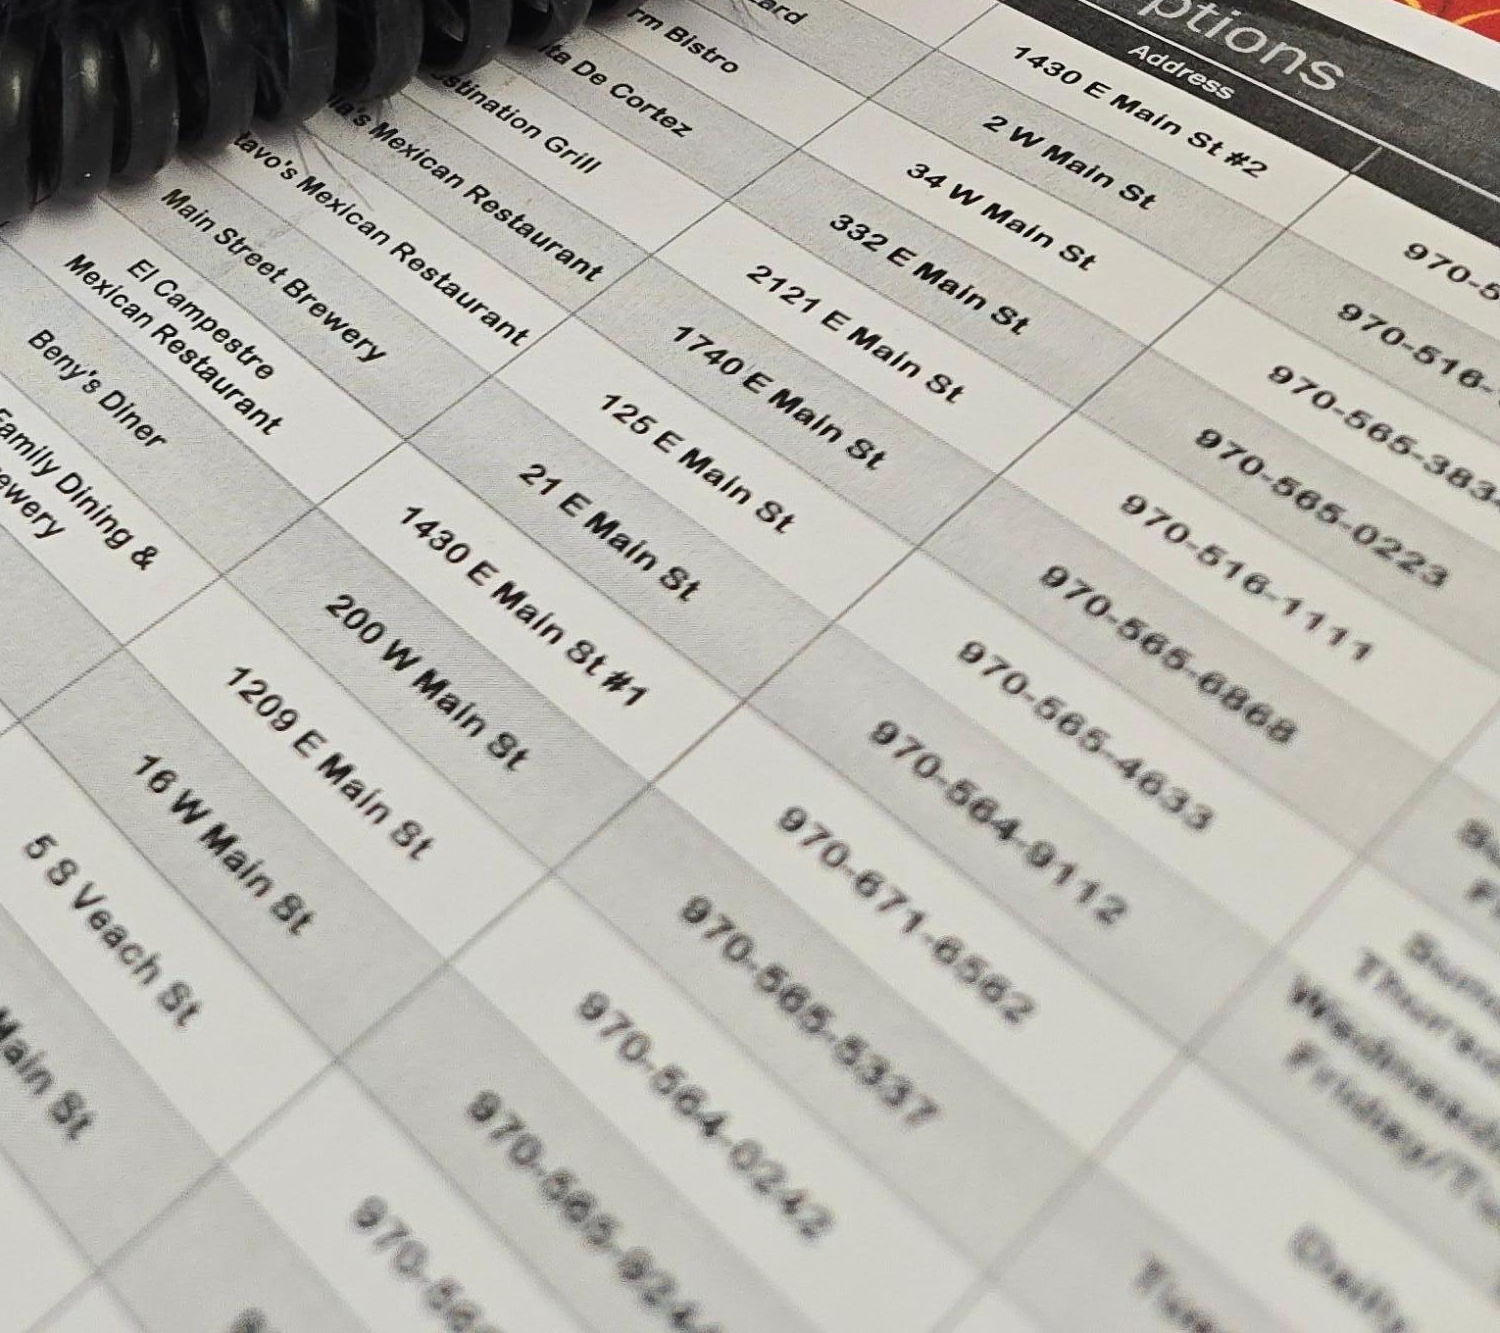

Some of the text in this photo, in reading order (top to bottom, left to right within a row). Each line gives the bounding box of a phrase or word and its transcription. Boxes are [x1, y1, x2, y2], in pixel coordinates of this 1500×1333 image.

[571, 60, 695, 139] De Cortez
[663, 24, 740, 76] Bistro
[1012, 45, 1270, 181] 1430 E Main St #2
[1128, 44, 1236, 102] Address
[368, 120, 606, 285] Mexican Restaurant
[544, 135, 603, 176] Grill
[906, 162, 1099, 274] 34 W Main St
[983, 114, 1158, 212] 2 W Main St
[127, 258, 276, 382] El Campestre
[160, 187, 388, 365] Main Street Brewery
[295, 174, 403, 249] Mexican
[390, 239, 534, 349] Restaurant
[829, 212, 1034, 338] 332 E Main St
[26, 328, 169, 451] Beny's Diner
[64, 253, 286, 438] Mexican Restaurant
[673, 324, 889, 473] 1740 E Main St
[747, 263, 967, 407] 2121 E Main St
[1337, 301, 1500, 405] 970-516-
[54, 472, 135, 551] Dining
[132, 544, 162, 574] &
[519, 462, 704, 604] 21 E Main St
[600, 393, 799, 536] 125 E Main St
[1195, 427, 1452, 590] 970-565-0223
[399, 505, 649, 708] 1430 E Main St #1
[1119, 493, 1376, 663] 970-516-1111
[325, 593, 531, 774] 200 W Main St
[1039, 564, 1300, 747] 970-565-6868
[225, 664, 438, 862] 1209 E Main St
[956, 640, 1214, 833] 970-565-4633
[133, 753, 316, 936] 16 W Main St
[22, 833, 203, 1029] 5 S Veach St
[47, 1089, 95, 1142] St
